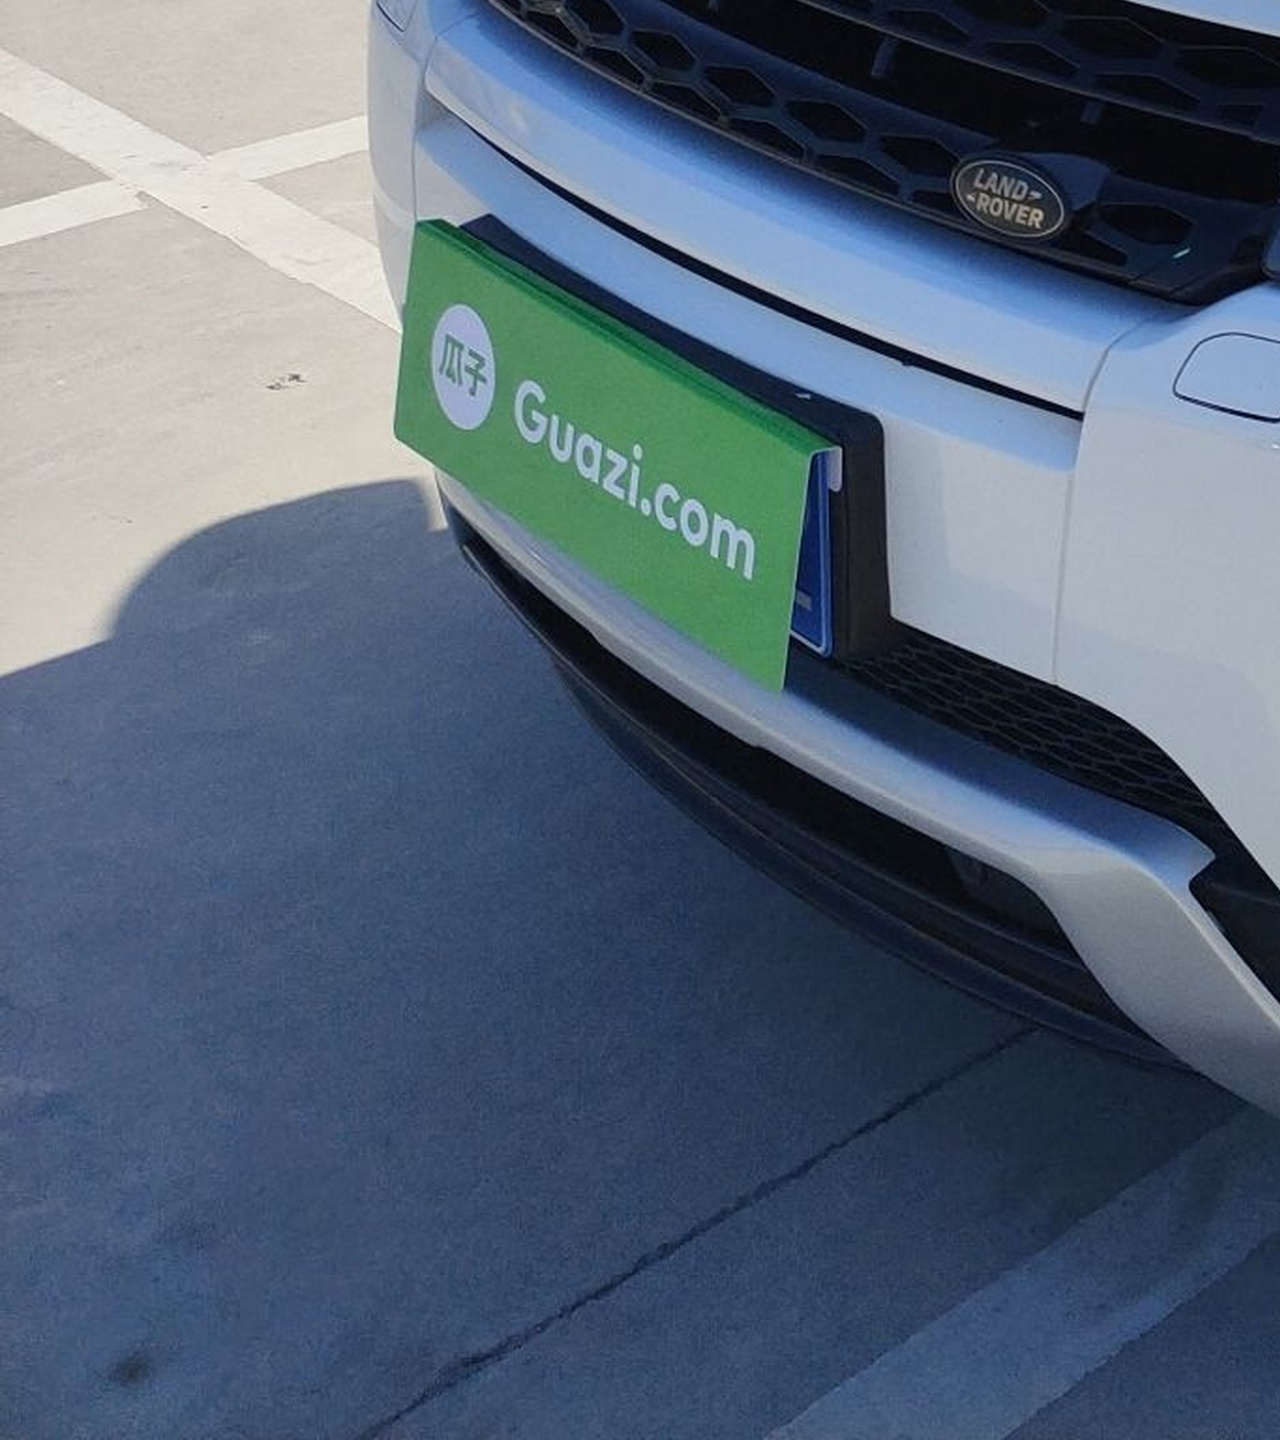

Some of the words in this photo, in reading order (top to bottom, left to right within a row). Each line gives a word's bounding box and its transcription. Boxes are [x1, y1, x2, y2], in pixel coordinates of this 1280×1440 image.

[974, 167, 1030, 201] LAND
[975, 192, 1044, 229] ROVER
[438, 335, 487, 397] 瓜子
[515, 380, 755, 579] Guazi.com
